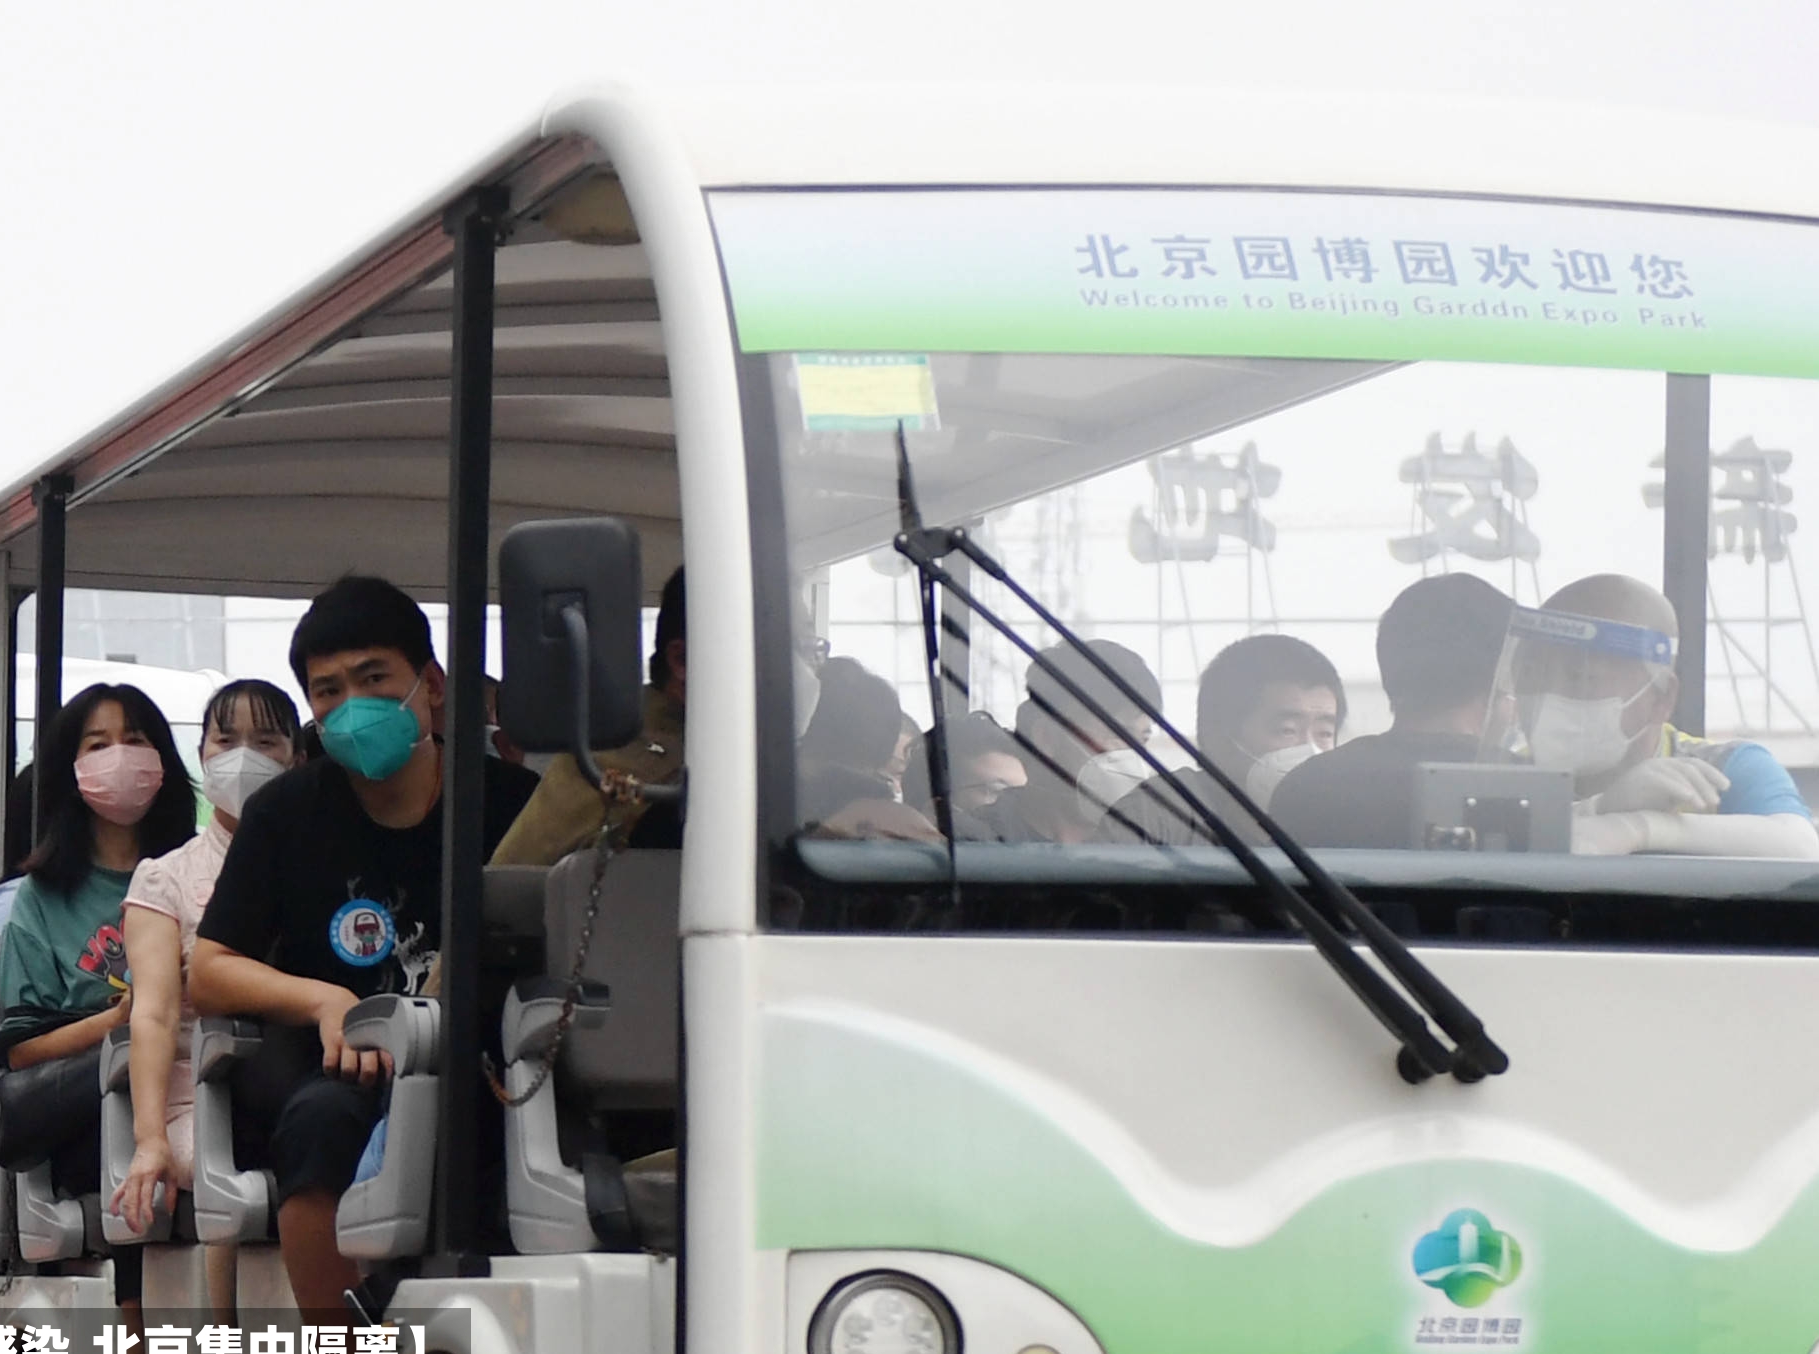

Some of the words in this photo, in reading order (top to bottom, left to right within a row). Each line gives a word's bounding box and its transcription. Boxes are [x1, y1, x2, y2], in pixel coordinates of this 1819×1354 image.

[1074, 233, 1694, 299] 北京园博园欢迎您
[1080, 288, 1229, 310] Welcome
[1243, 293, 1274, 311] to
[1289, 291, 1400, 317] Beijing
[1543, 301, 1618, 325] Expo
[1639, 307, 1707, 329] Park
